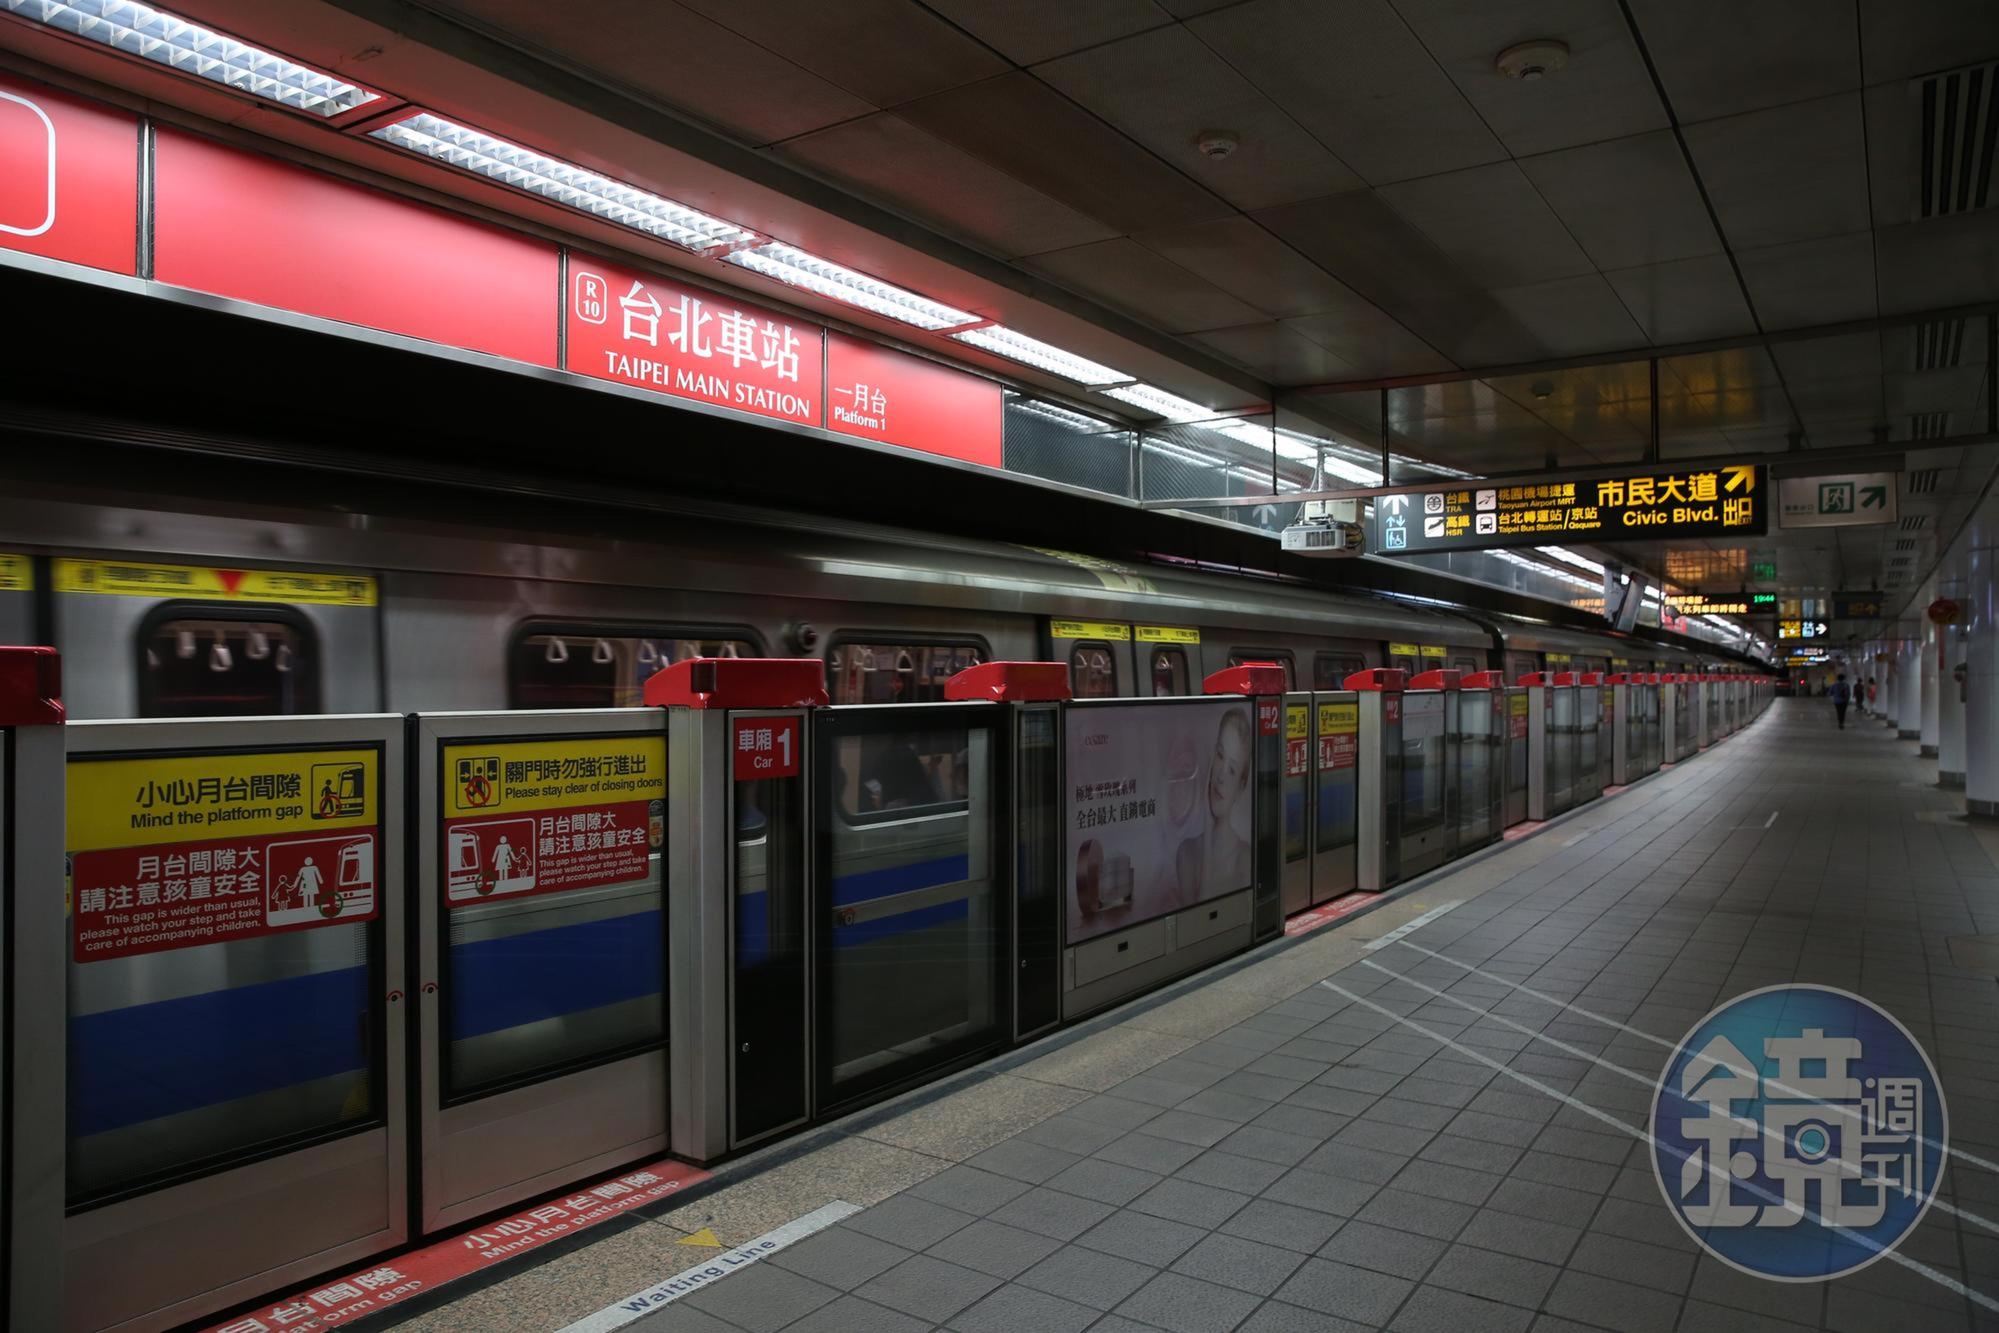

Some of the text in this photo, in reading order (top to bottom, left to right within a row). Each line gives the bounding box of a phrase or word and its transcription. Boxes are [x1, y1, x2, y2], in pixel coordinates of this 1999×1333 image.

[585, 280, 597, 298] R
[583, 299, 600, 318] 10
[619, 280, 801, 383] 台北車站
[605, 351, 810, 418] TAIPEI MAIN STATION
[834, 383, 887, 416] 一月台
[835, 406, 886, 431] Platform 1
[1498, 484, 1576, 500] 桃園機場捷運
[1597, 472, 1718, 507] 市民大道
[1446, 505, 1462, 513] TRA
[1498, 497, 1576, 510] Taoyuan Airport MRT
[1623, 506, 1719, 526] Civic Blvd.
[1723, 497, 1752, 526] 出口
[1446, 515, 1470, 528] 高鐵
[1446, 529, 1463, 537] HSR
[1499, 525, 1519, 534] Taipei
[1536, 523, 1563, 531] Station
[1271, 706, 1278, 728] 2
[738, 728, 792, 766] 車廂 1
[505, 754, 646, 783] 關門時勿強行進出
[753, 755, 774, 769] Car
[135, 774, 302, 808] 小心月台間隙
[505, 777, 663, 799] Please stay clear of closing doors
[131, 804, 303, 828] Mind the platform gap
[539, 811, 617, 836] 月台間隙大
[540, 827, 646, 857] 請注意孩童安全
[136, 847, 261, 881] 月台間隙大
[540, 859, 555, 869] This
[556, 858, 569, 868] gap
[579, 854, 597, 864] wider
[599, 852, 614, 860] than
[540, 856, 646, 878] please watch your step and take
[540, 877, 555, 886] care
[557, 876, 565, 884] of
[566, 869, 615, 882] accompanying
[80, 871, 261, 913] 請注意孩童安全
[104, 897, 261, 925] This gap is wider than usual,
[80, 908, 261, 942] please watch your step and take
[86, 919, 261, 952] care of accompanying children.
[463, 1171, 664, 1249] 小心月台間隙
[480, 1179, 680, 1259] Mind the platform gap
[620, 1239, 776, 1313] Waiting Line
[217, 1266, 407, 1333] 月台間隙
[377, 1280, 423, 1300] gap
